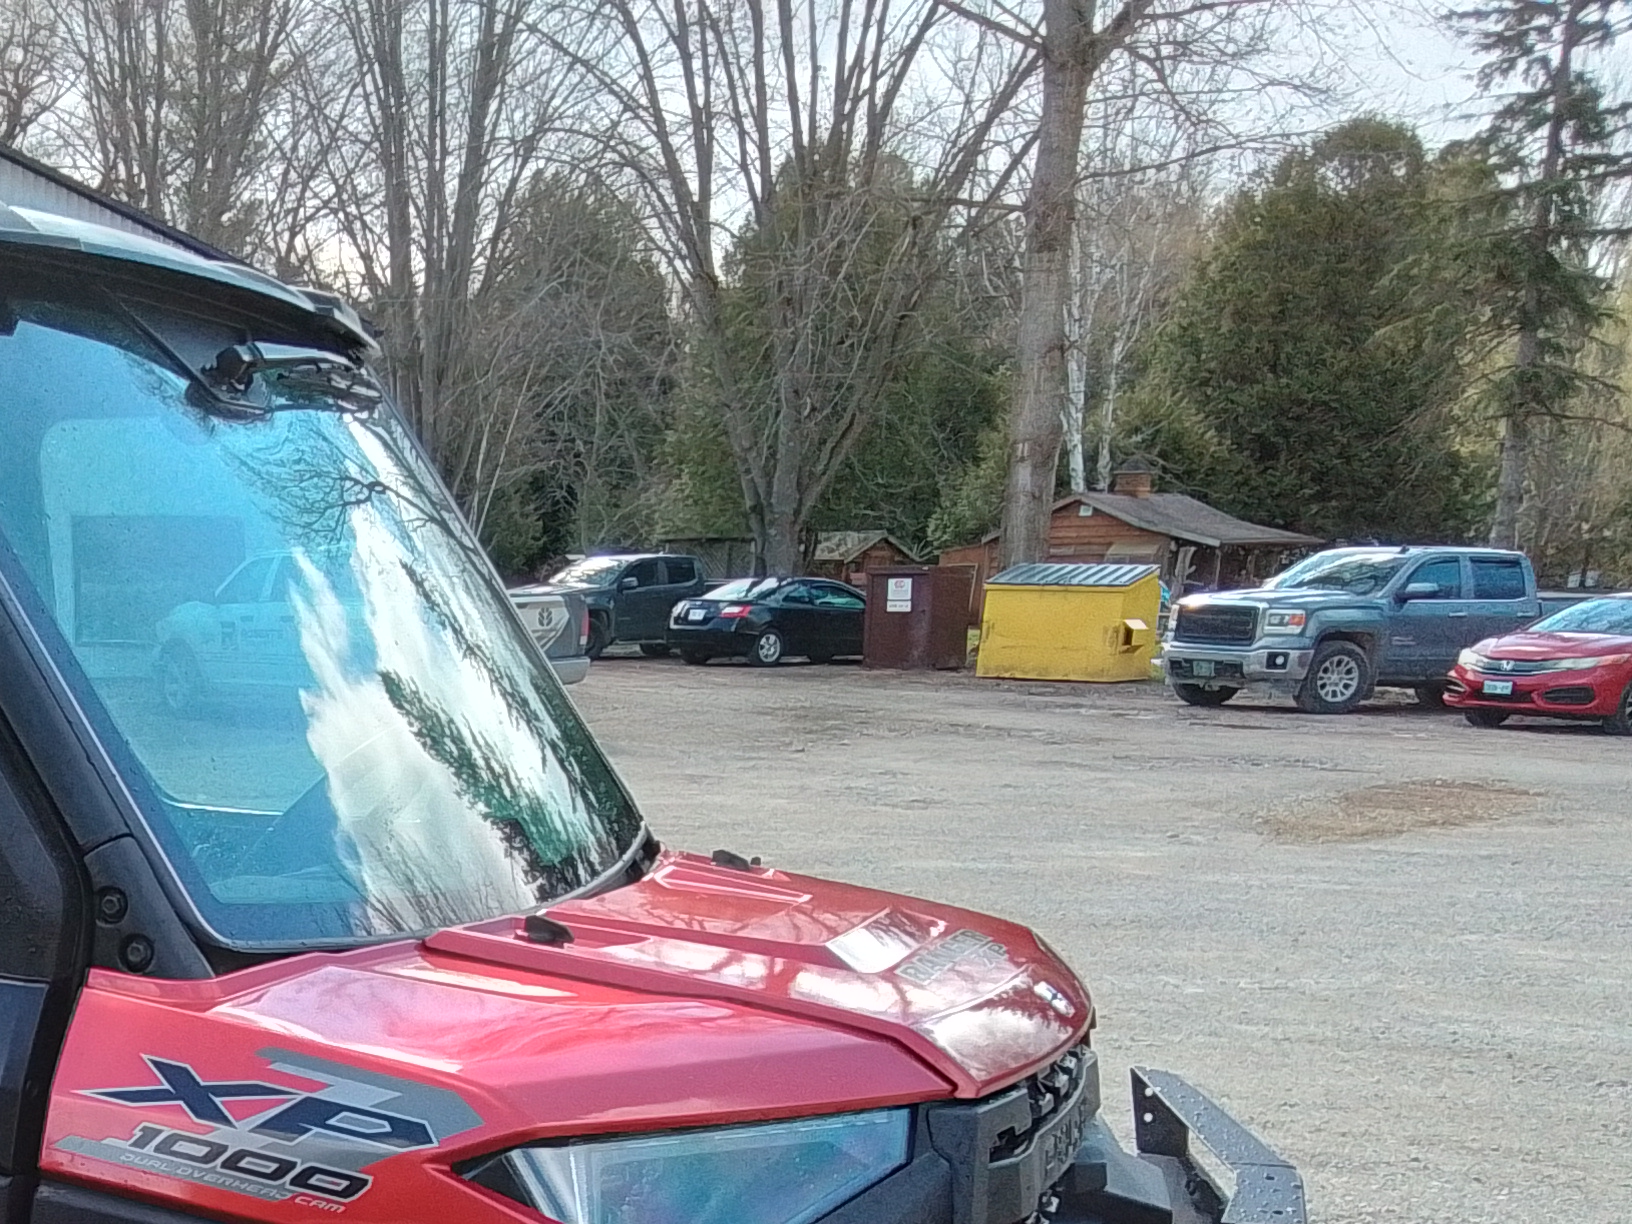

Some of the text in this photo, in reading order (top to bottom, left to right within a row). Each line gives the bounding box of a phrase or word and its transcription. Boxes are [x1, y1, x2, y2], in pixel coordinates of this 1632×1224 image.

[69, 1053, 439, 1149] XP
[119, 1153, 347, 1213] DUAL OVERHEAD CAM
[126, 1122, 373, 1203] 1000
